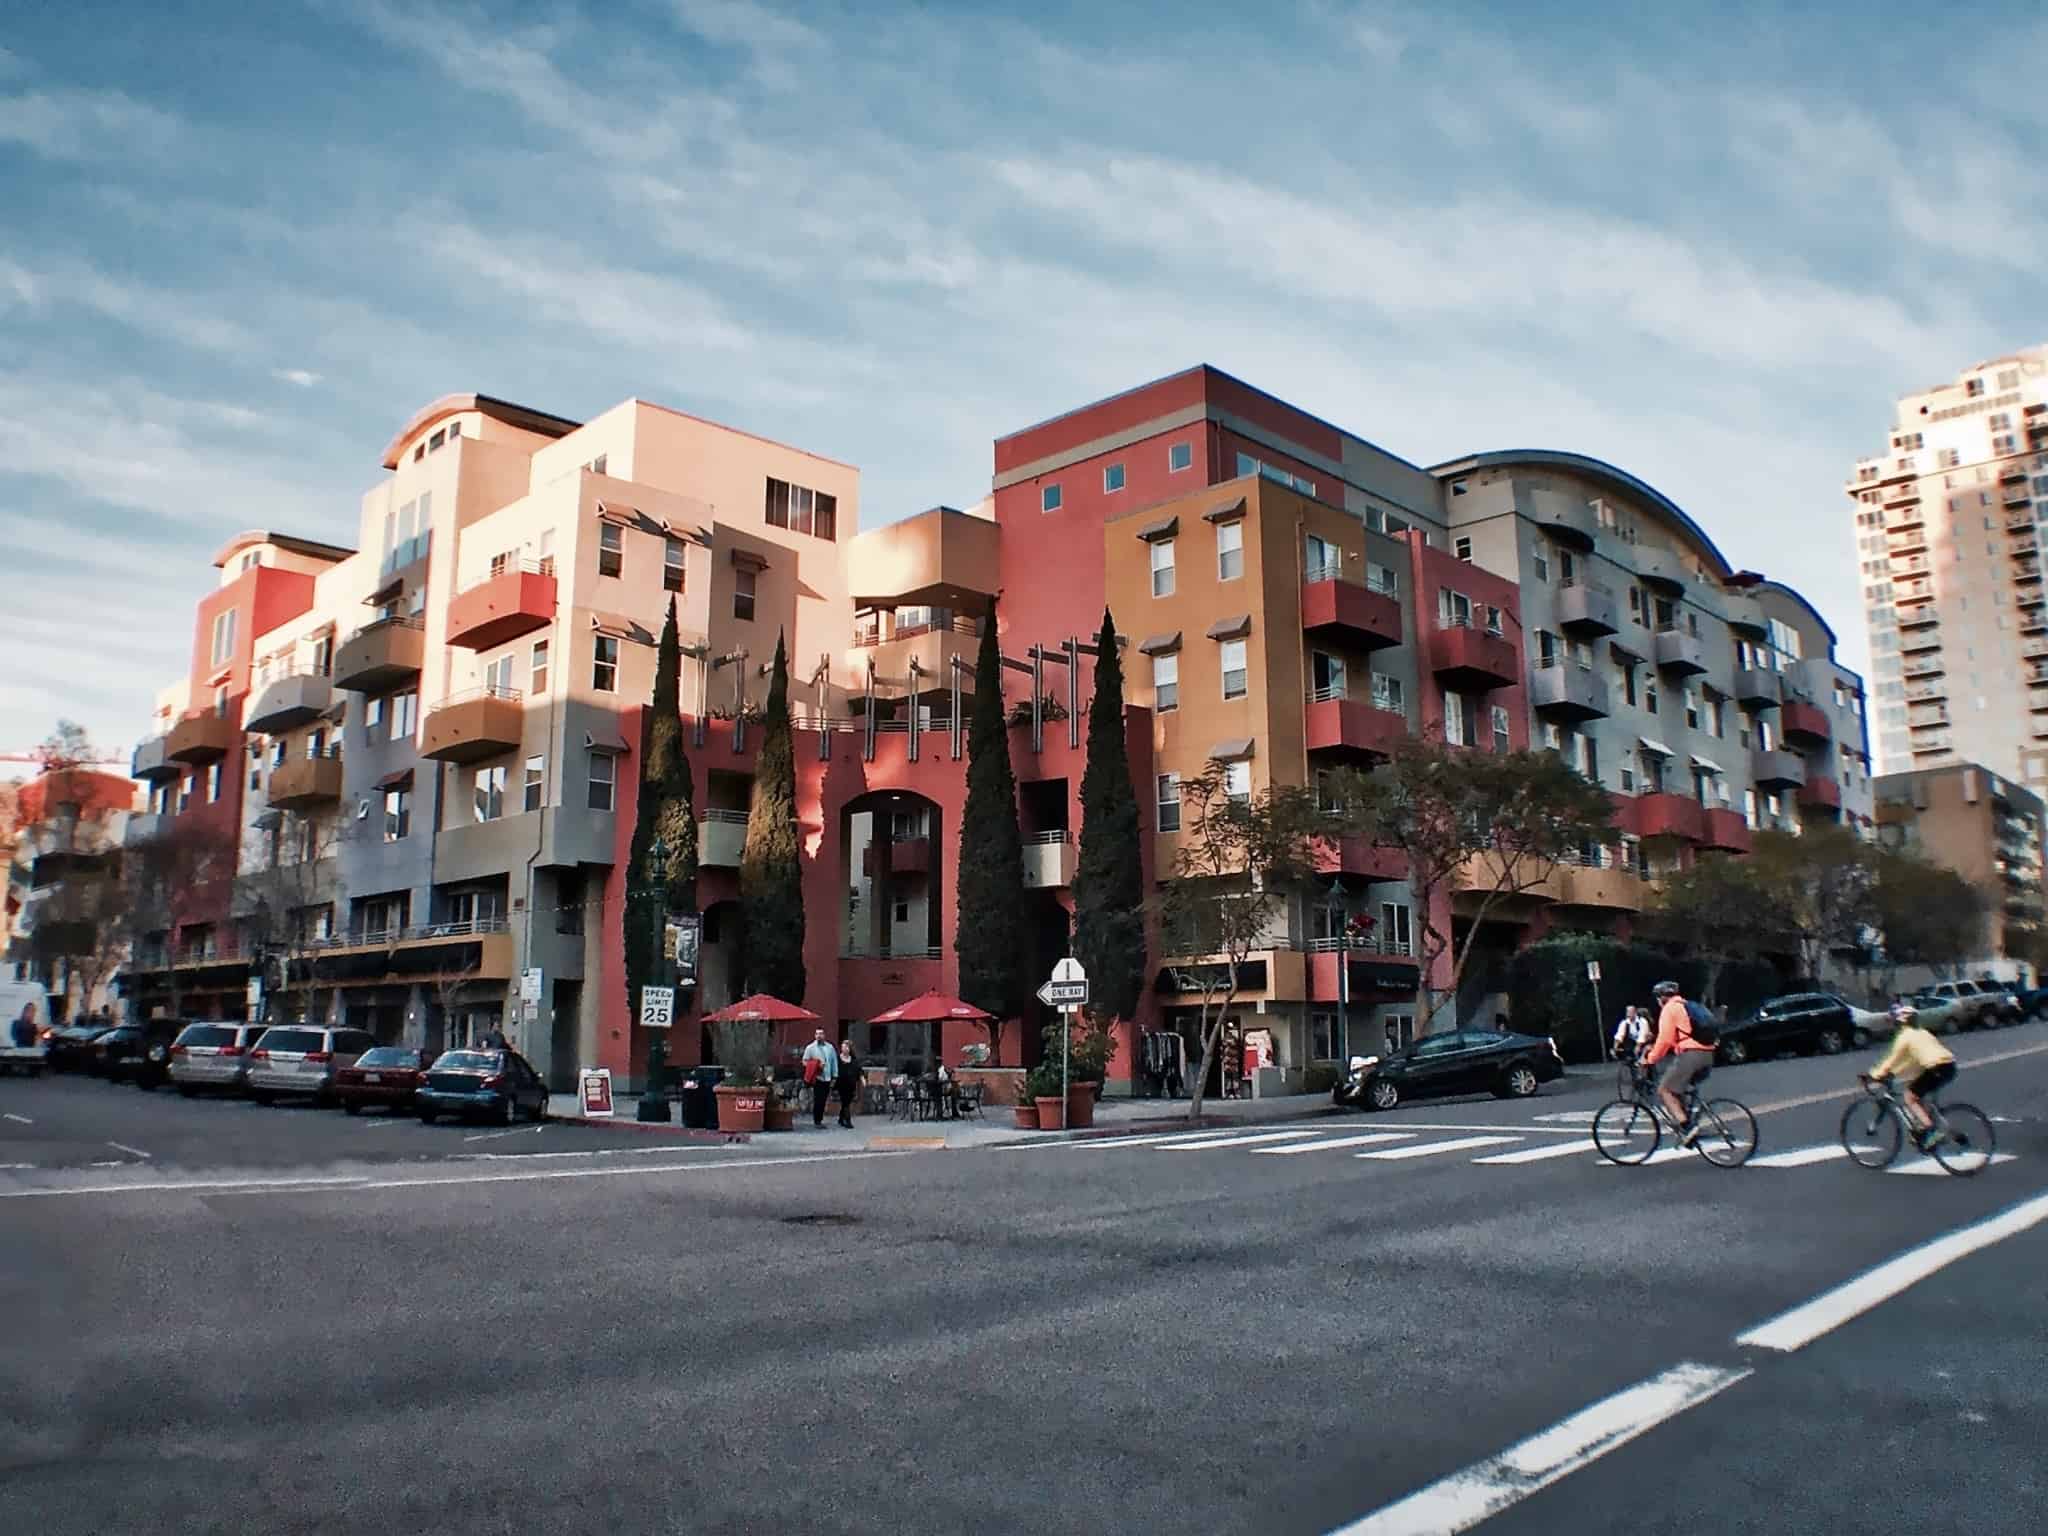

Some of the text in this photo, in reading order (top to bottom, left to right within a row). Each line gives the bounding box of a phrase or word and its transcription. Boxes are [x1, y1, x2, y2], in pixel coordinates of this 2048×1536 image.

[645, 990, 673, 998] SPEED
[1052, 989, 1066, 997] ONE
[643, 1008, 668, 1022] 25
